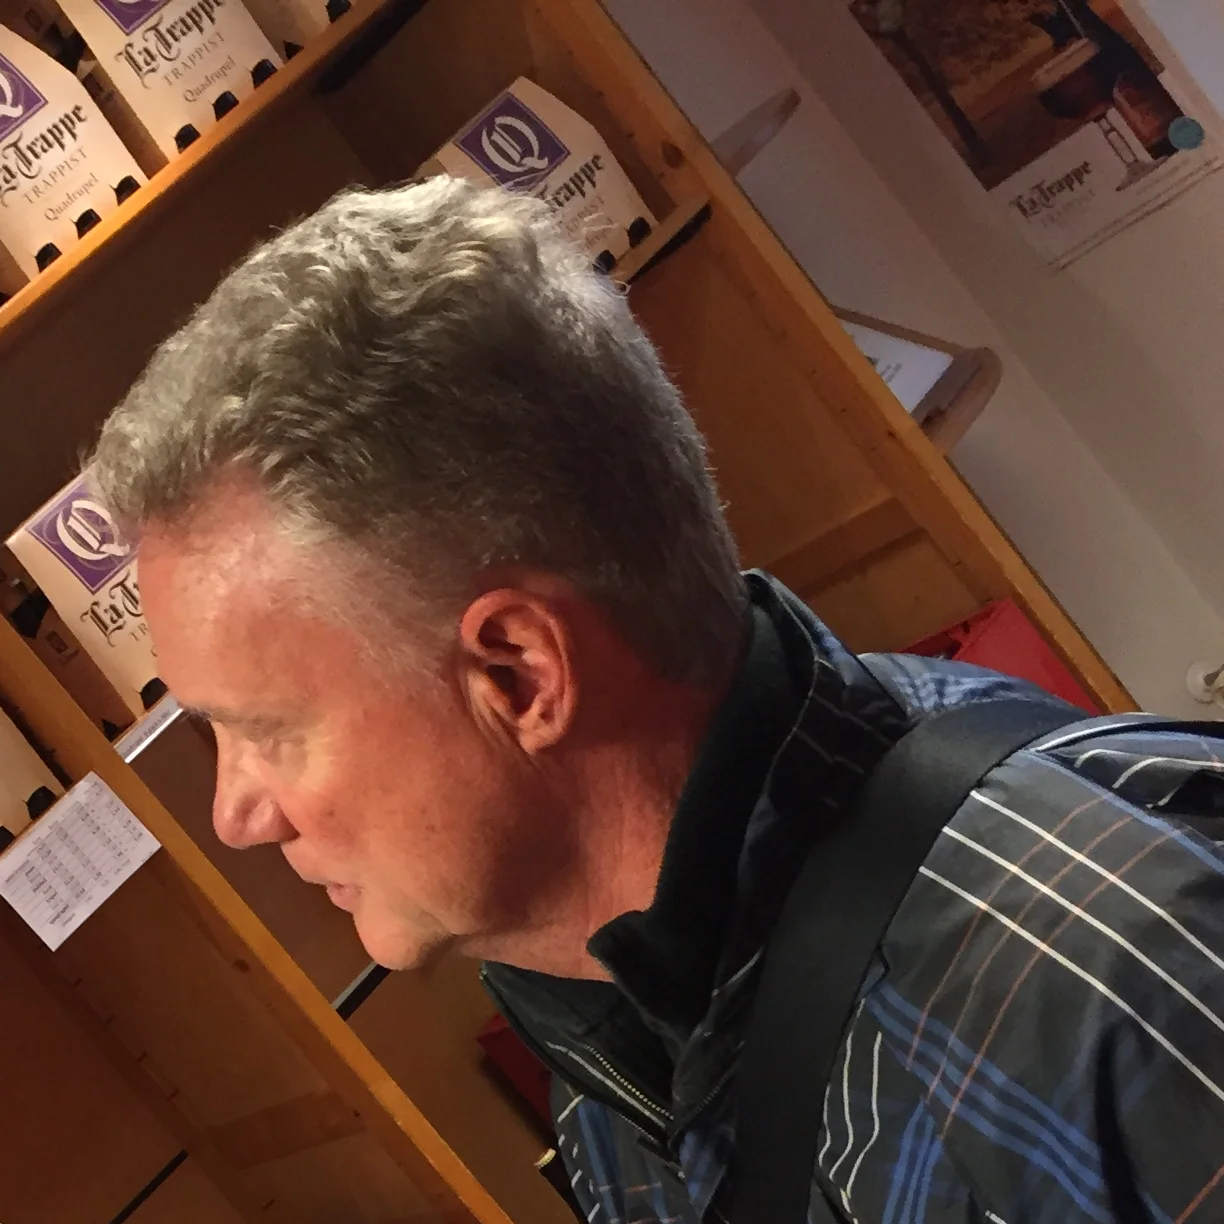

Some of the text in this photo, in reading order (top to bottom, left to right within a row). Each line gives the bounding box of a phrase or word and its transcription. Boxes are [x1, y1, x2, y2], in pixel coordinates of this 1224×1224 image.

[163, 32, 225, 86] TRAPPIST
[182, 54, 237, 102] Quadrupel
[481, 115, 549, 173] Q
[22, 146, 88, 203] TRAPPIST
[44, 172, 99, 221] Quadrupel
